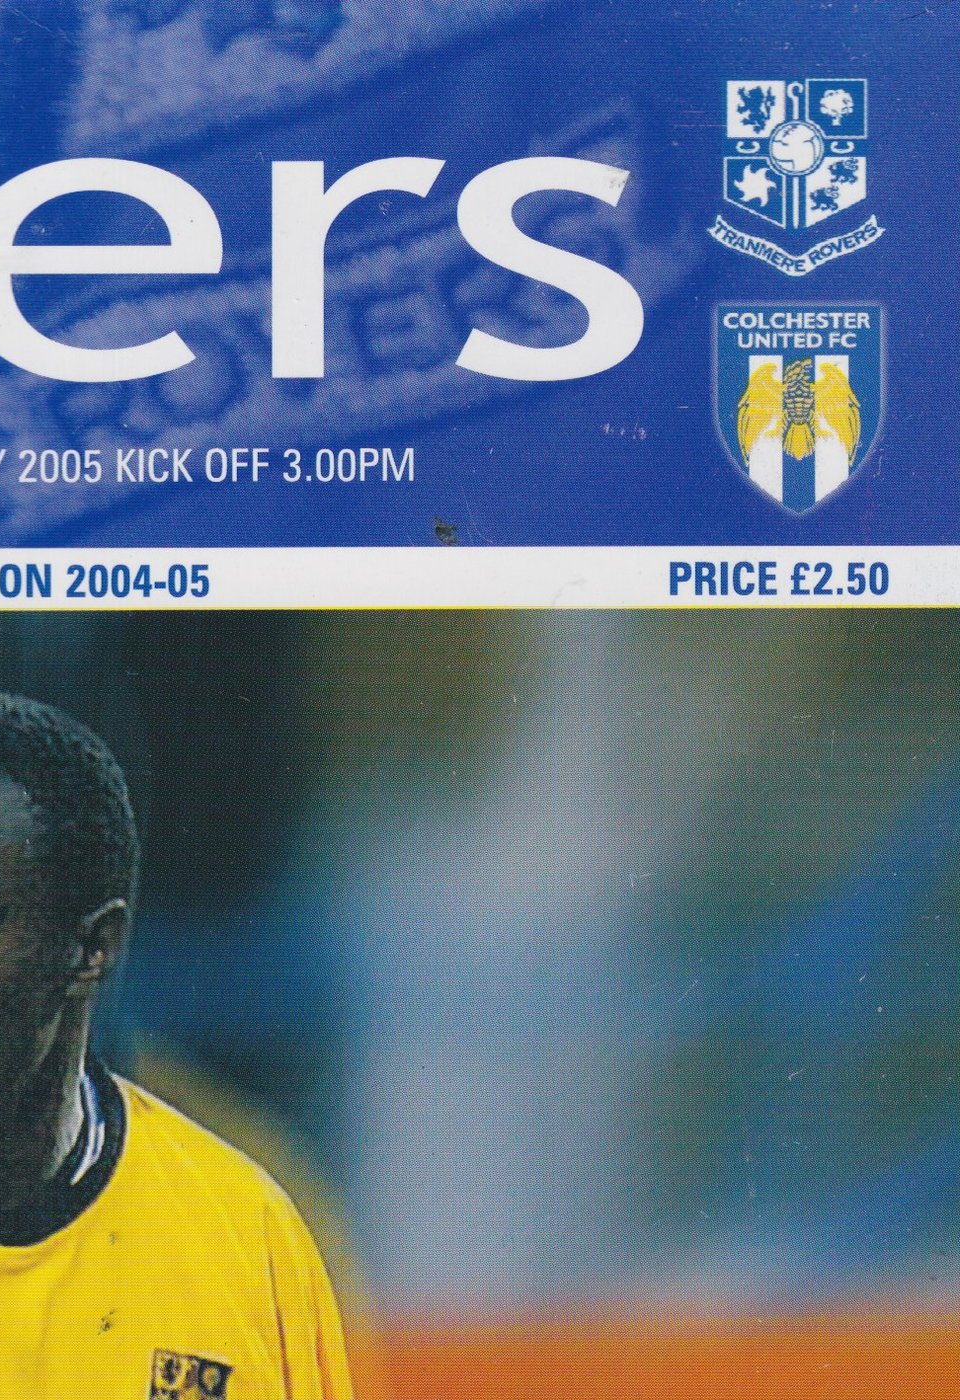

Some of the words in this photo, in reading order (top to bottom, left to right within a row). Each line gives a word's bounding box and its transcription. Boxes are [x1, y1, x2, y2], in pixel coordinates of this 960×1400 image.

[715, 222, 806, 273] TRANMERE
[807, 222, 879, 265] ROVERS
[723, 312, 870, 329] COLCHESTER
[738, 333, 823, 348] UNITED
[830, 333, 857, 348] FC
[18, 449, 102, 484] 2005
[116, 448, 199, 483] KICK
[205, 447, 269, 483] OFF
[283, 448, 415, 482] 3.00PM
[66, 564, 210, 598] 2004-05
[669, 561, 777, 596] PRICE
[790, 561, 889, 596] £2.50
